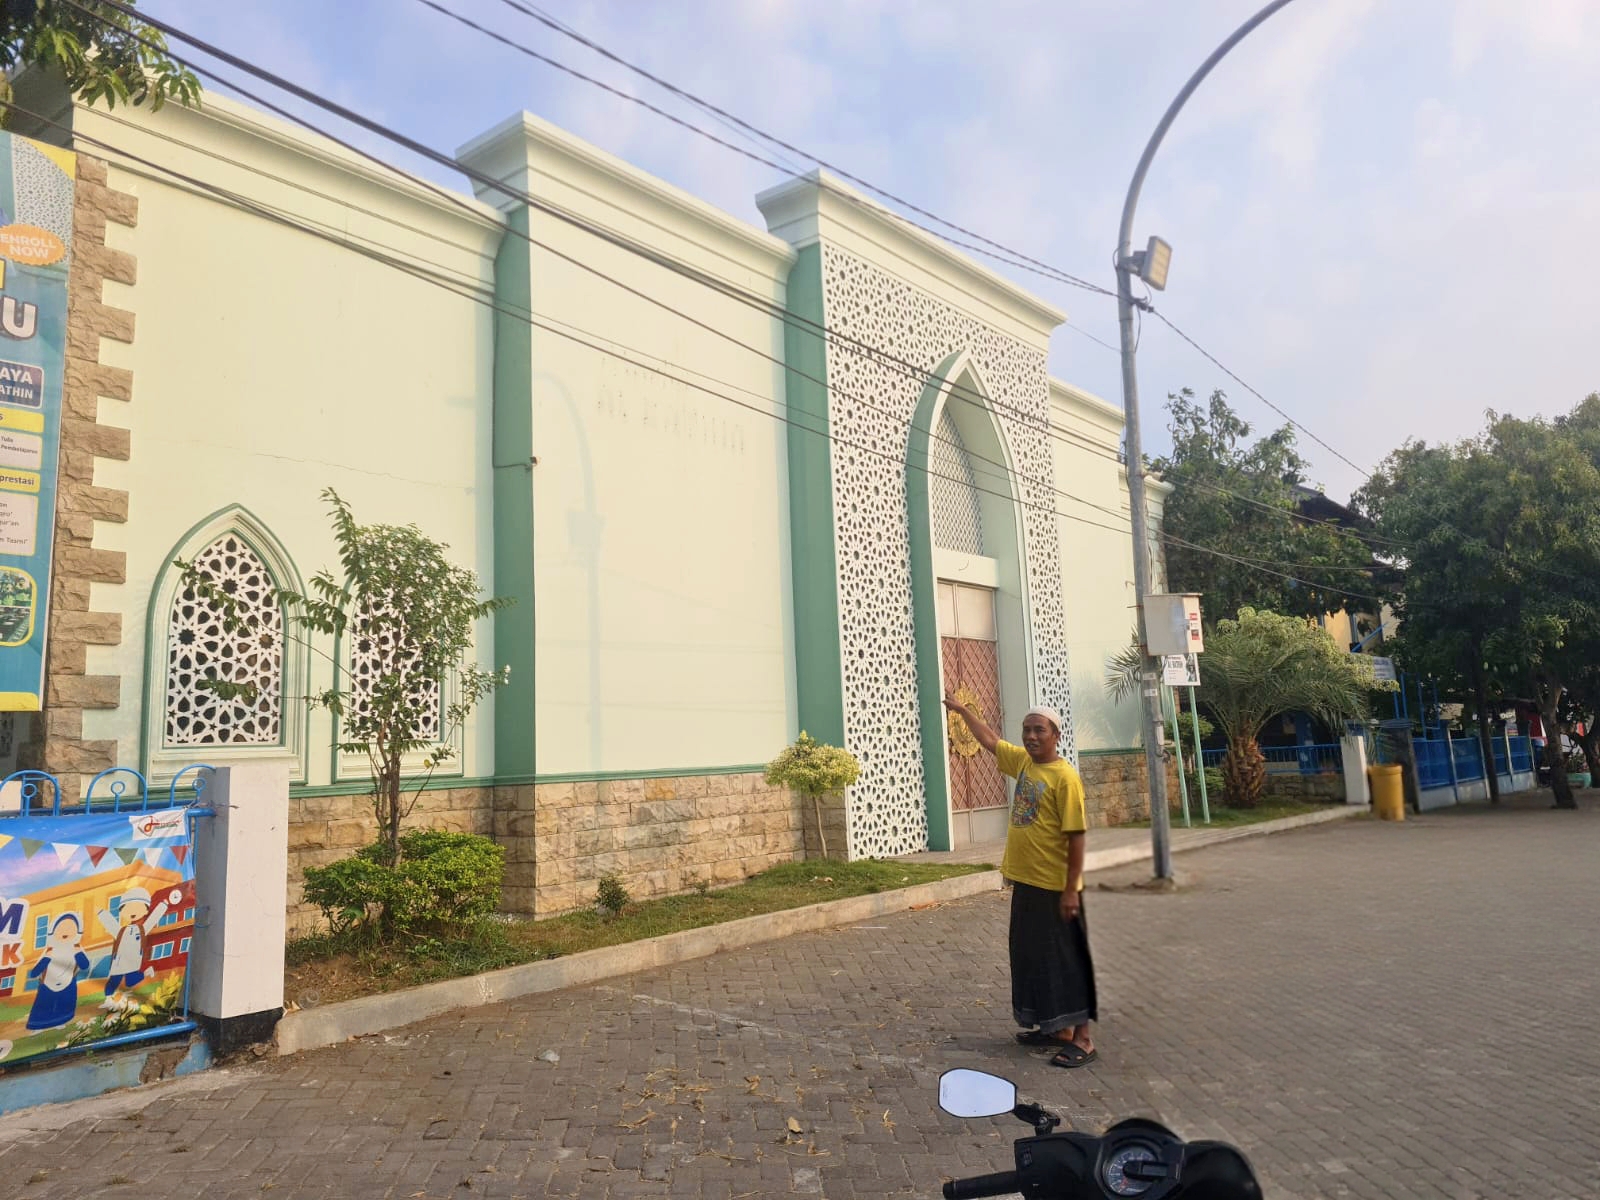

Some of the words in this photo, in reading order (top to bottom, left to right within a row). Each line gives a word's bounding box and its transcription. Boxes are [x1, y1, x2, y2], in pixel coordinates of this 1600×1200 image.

[0, 233, 57, 249] ENROLL
[9, 245, 49, 259] NOW
[0, 367, 33, 385] AYA
[0, 475, 35, 486] prestasi
[1, 942, 21, 967] K
